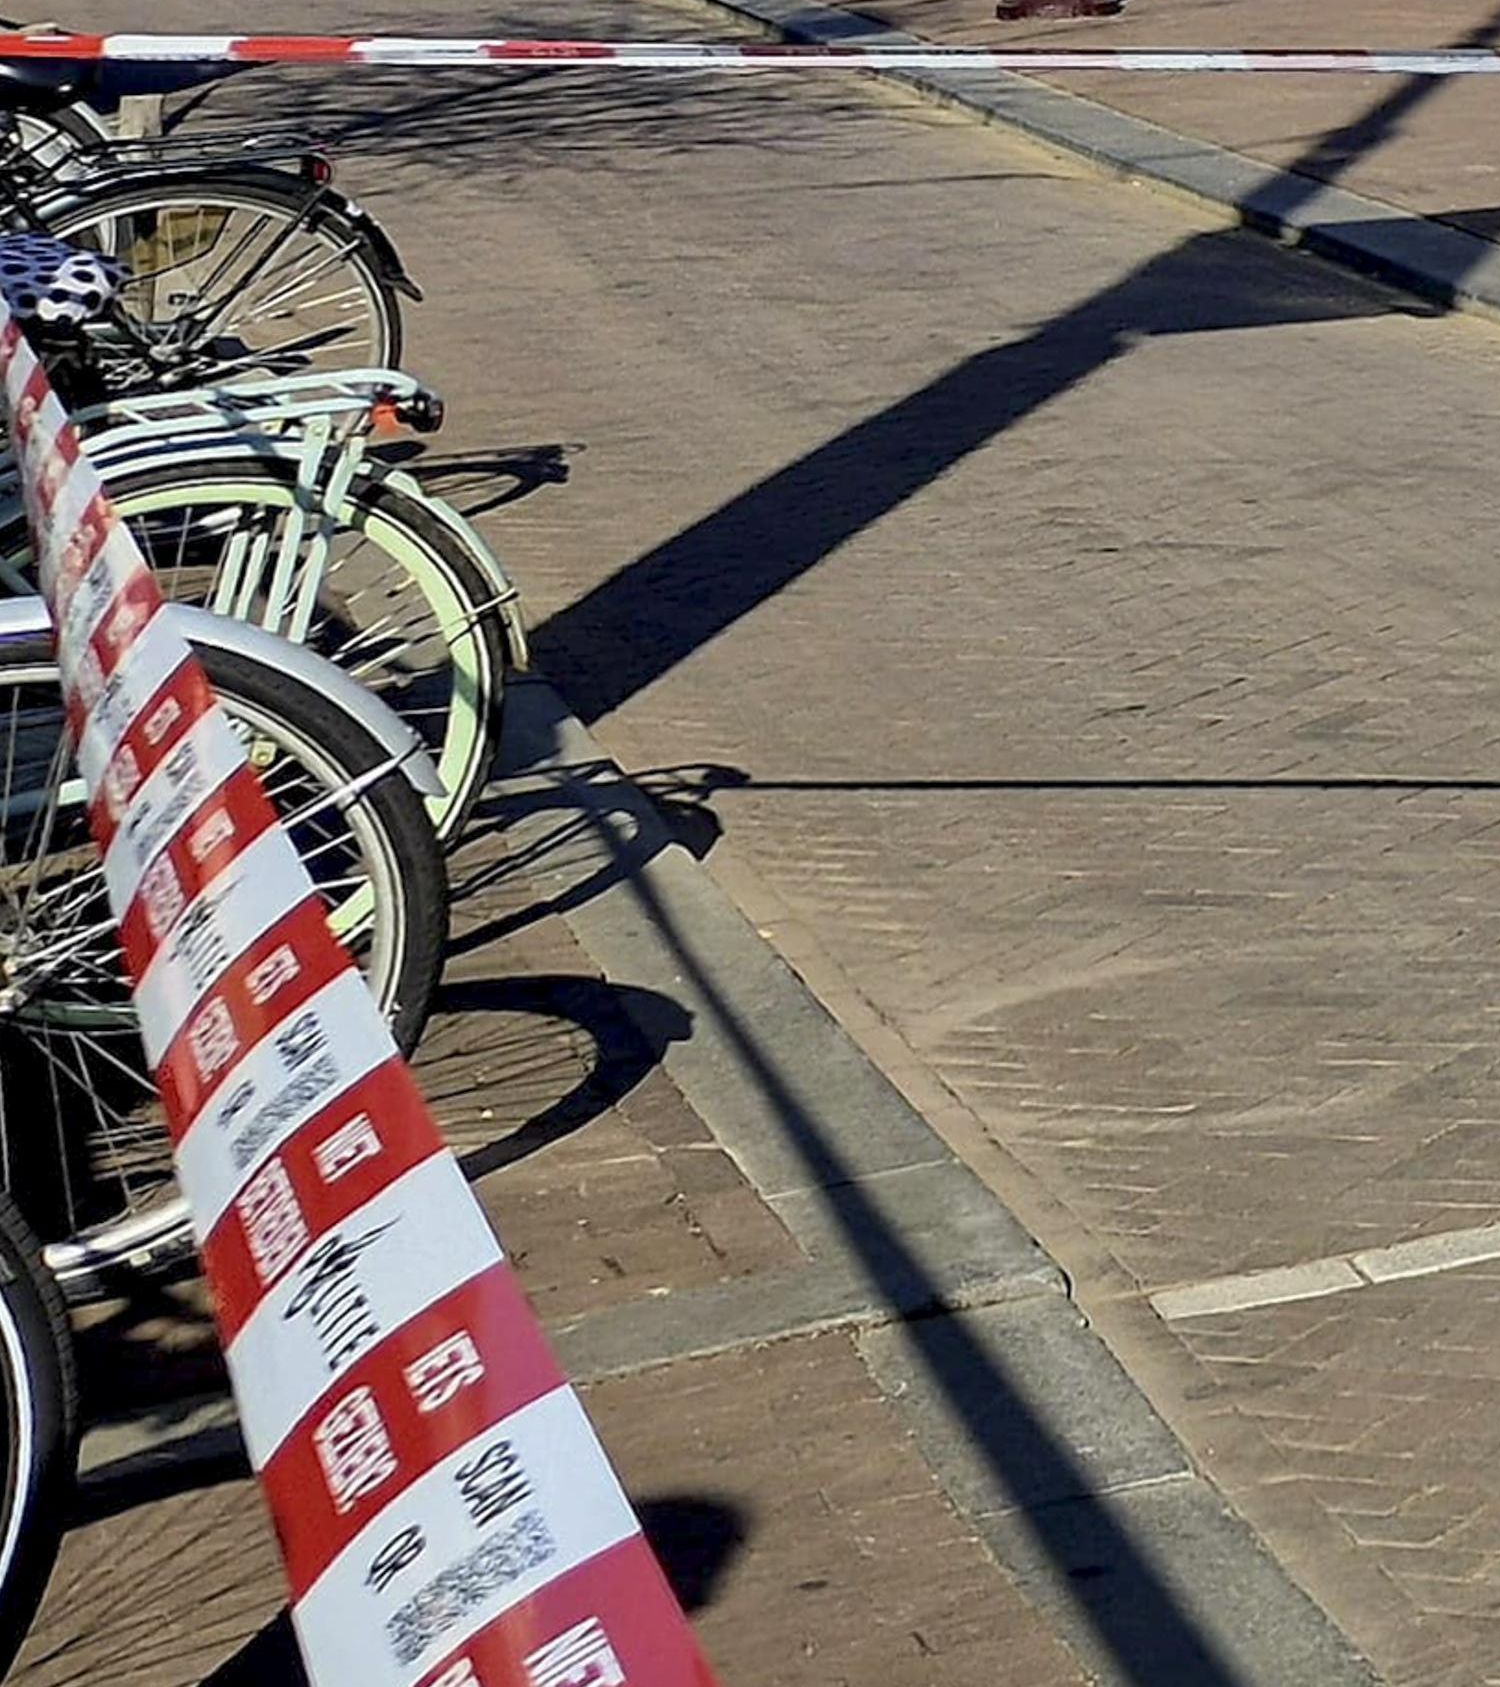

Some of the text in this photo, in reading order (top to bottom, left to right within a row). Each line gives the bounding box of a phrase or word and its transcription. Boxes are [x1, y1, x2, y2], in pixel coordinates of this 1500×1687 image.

[313, 1113, 384, 1184] NIET
[401, 1329, 486, 1413] IETS
[312, 1385, 400, 1515] GEZIEN?
[453, 1437, 532, 1529] SCAN
[364, 1522, 429, 1593] QR
